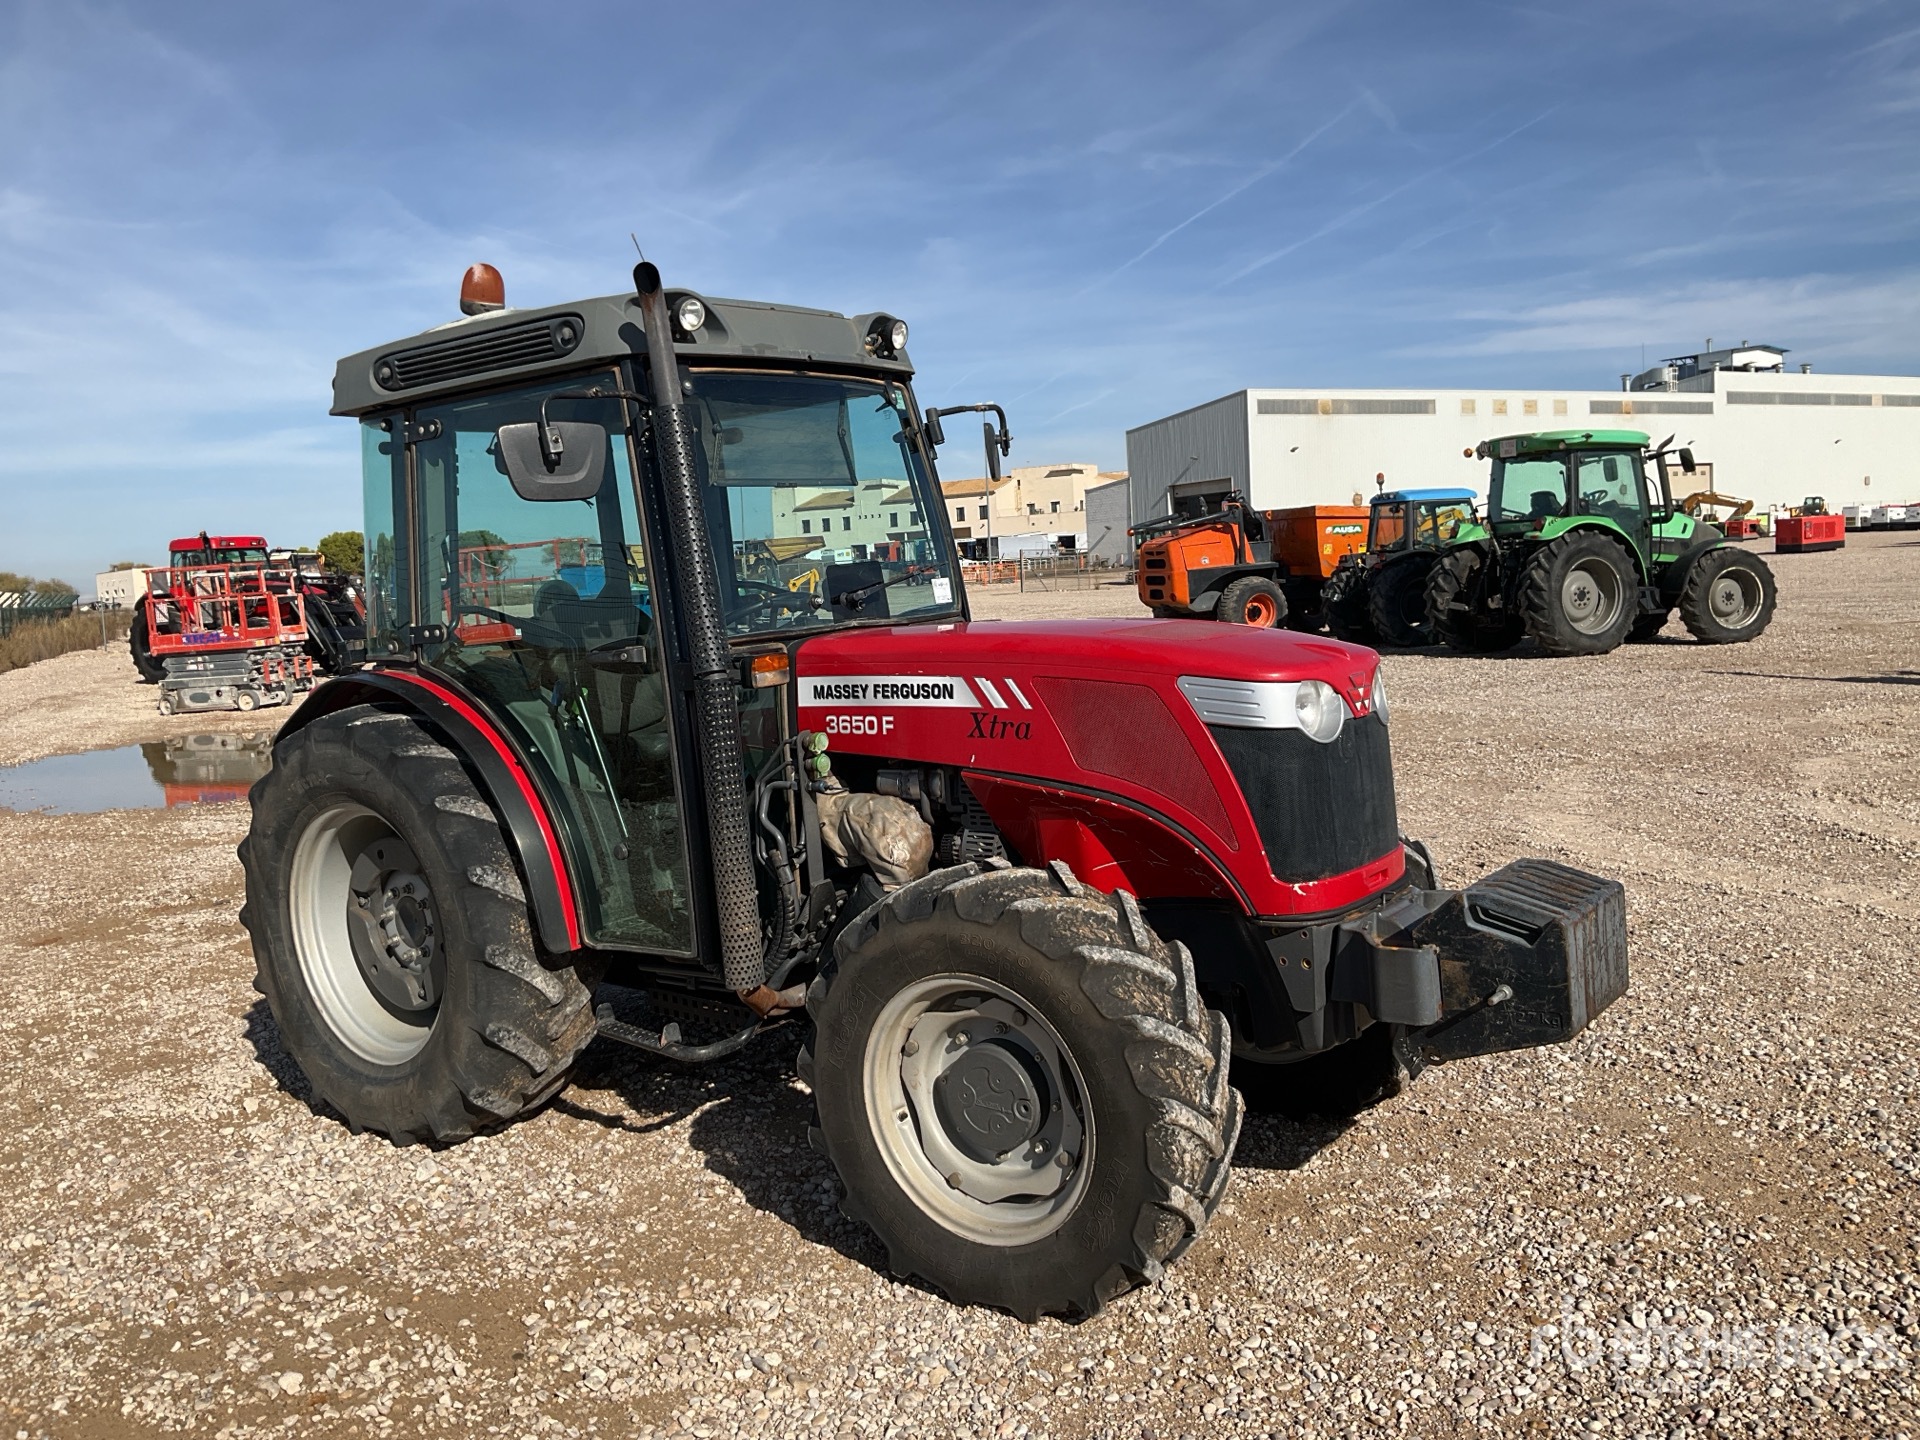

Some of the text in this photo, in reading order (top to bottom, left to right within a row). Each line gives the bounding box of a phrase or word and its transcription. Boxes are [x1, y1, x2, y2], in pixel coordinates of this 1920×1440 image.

[813, 683, 954, 700] MASSEY FERGUSON
[825, 715, 895, 735] 3650 F
[967, 711, 1033, 740] Xtra
[827, 981, 870, 1072] Kleber
[1086, 1157, 1130, 1252] Kleber
